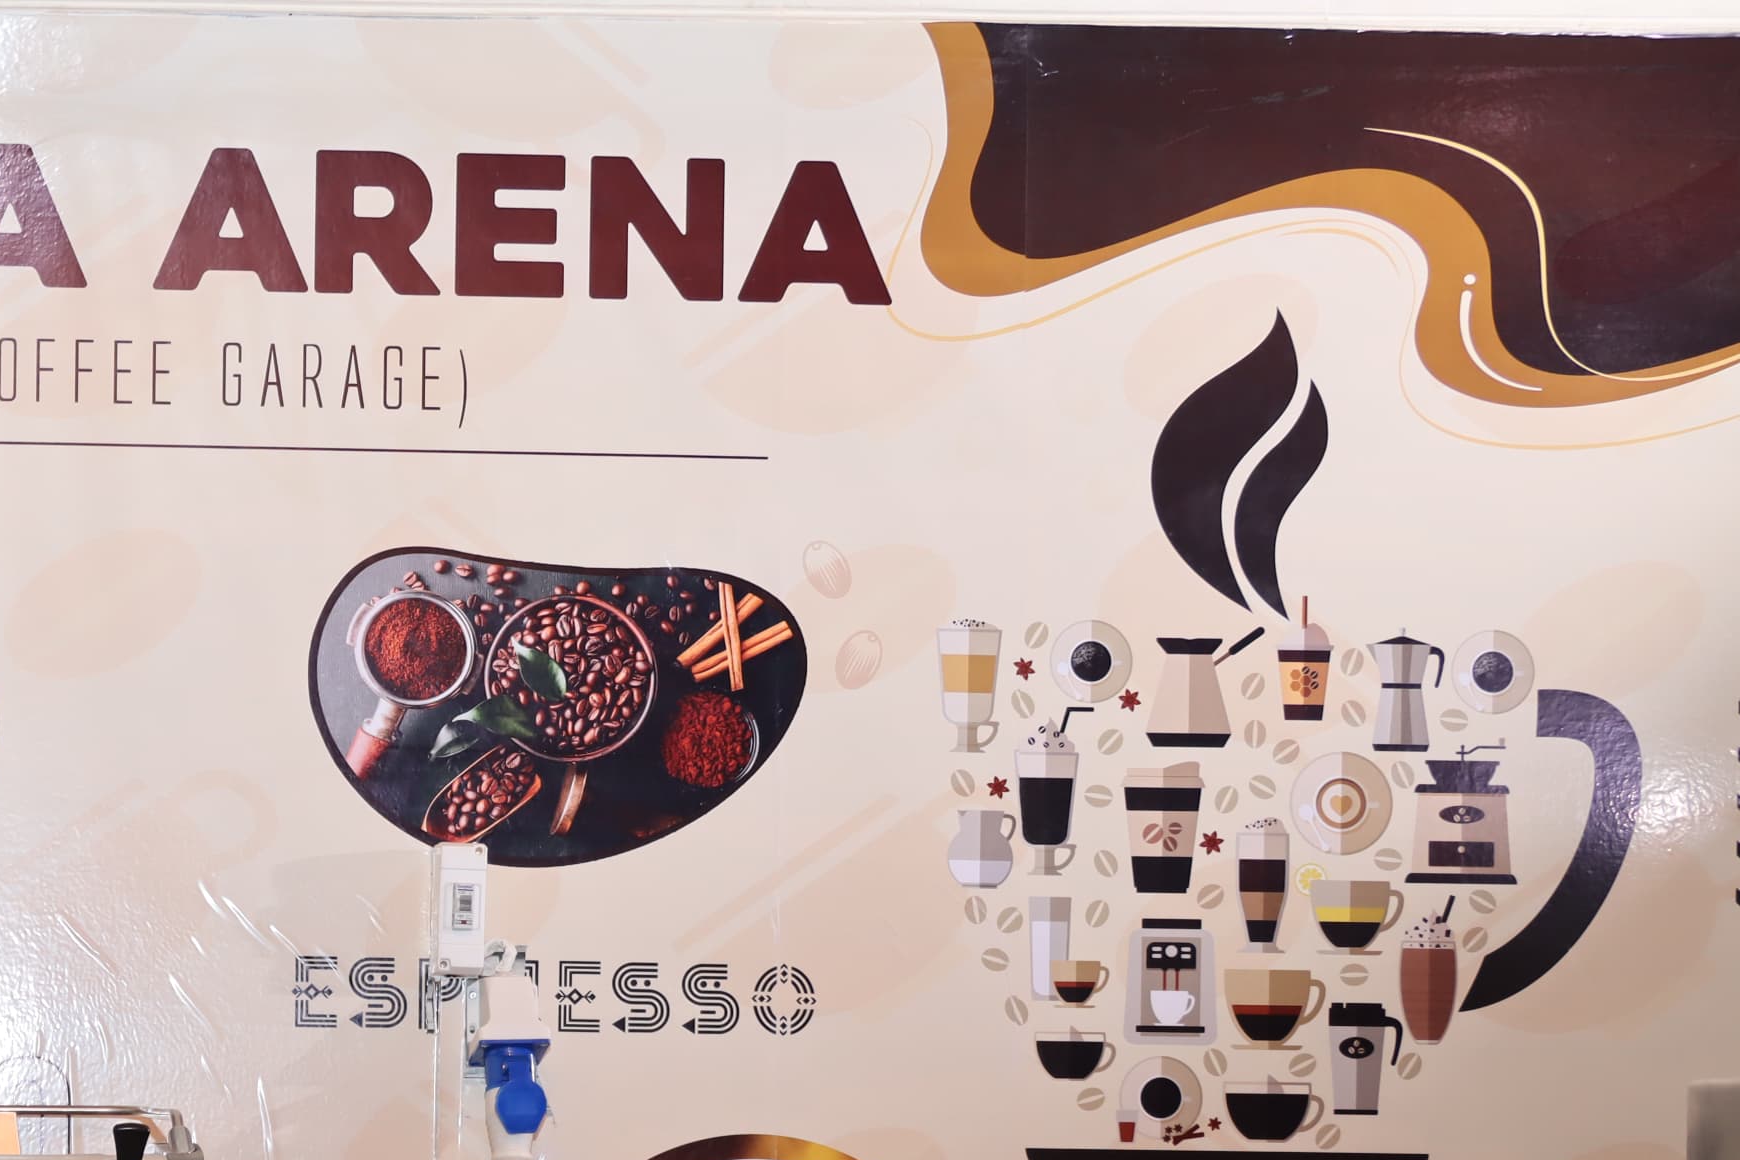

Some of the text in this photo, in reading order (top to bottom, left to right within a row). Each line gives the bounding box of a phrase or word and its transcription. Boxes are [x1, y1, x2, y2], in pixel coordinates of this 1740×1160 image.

[152, 147, 893, 306] ARENA
[221, 341, 469, 429] GARAGE)
[291, 955, 817, 1036] ESPESSO
